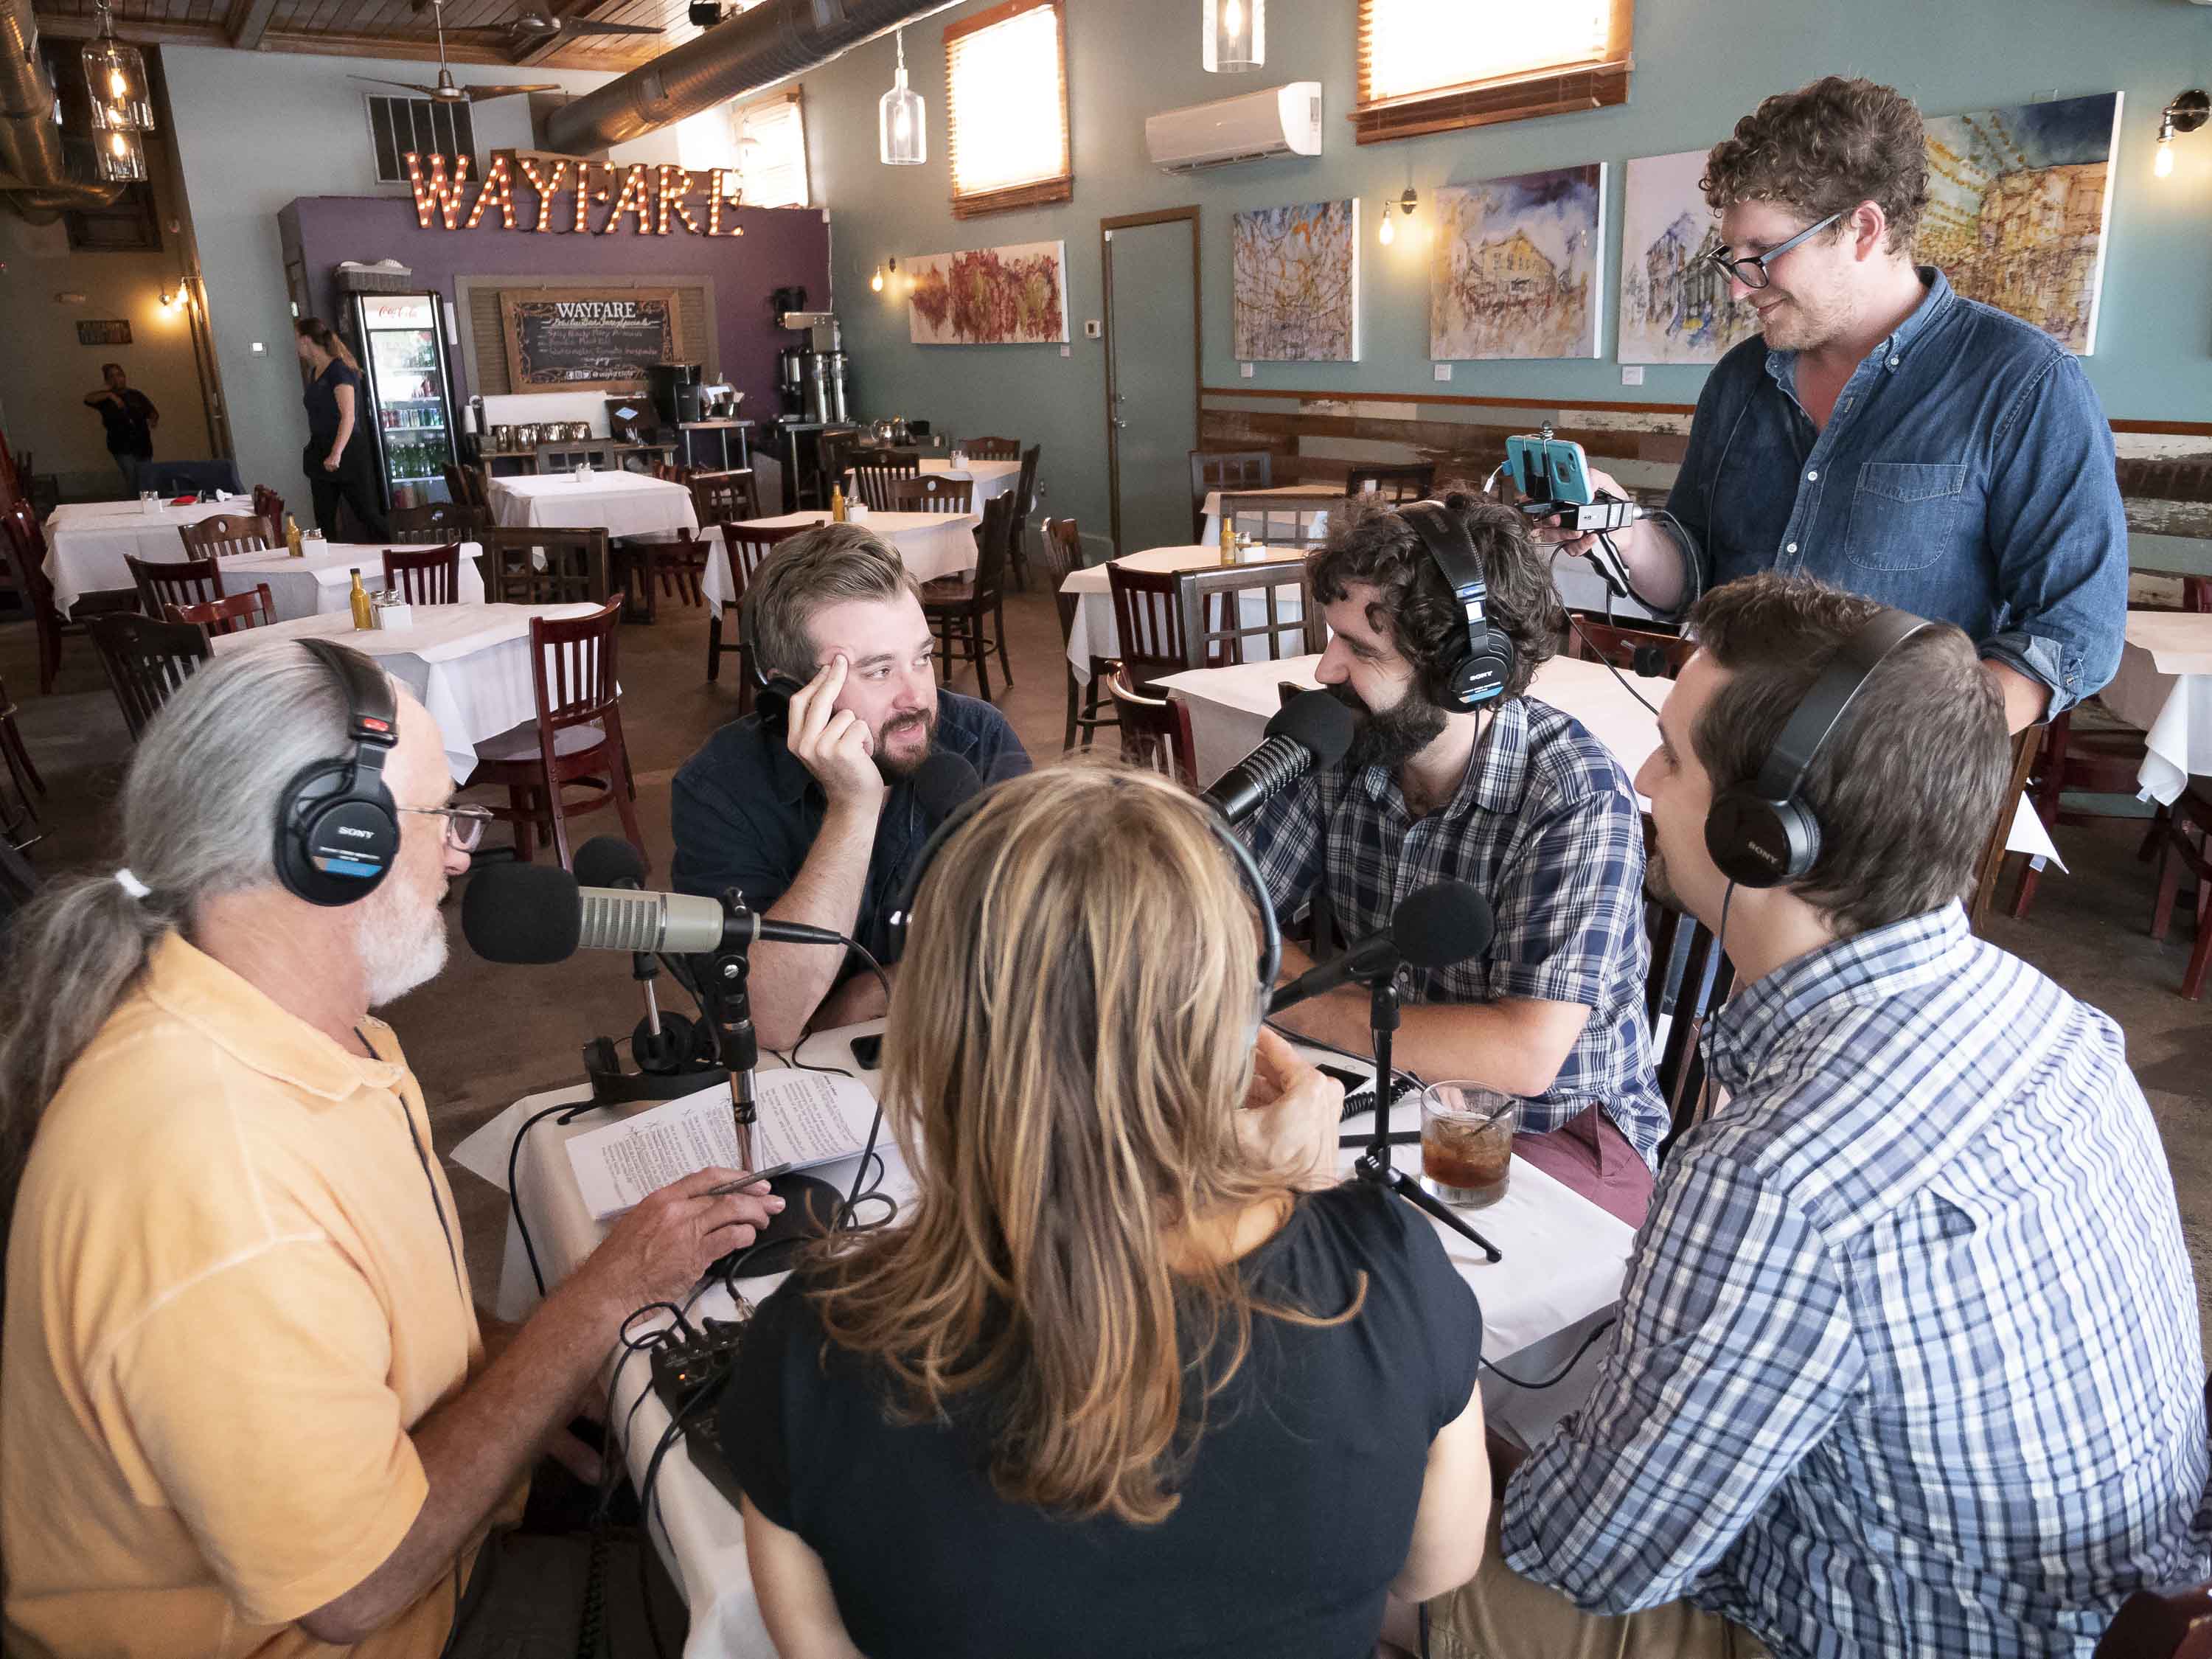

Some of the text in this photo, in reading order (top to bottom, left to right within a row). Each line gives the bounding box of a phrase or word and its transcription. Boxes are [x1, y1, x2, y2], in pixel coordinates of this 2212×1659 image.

[405, 152, 743, 236] WAYFARE
[556, 302, 636, 318] WAYFARE
[1470, 670, 1493, 681] SONY
[338, 827, 375, 839] SONY
[1748, 841, 1778, 863] SONY
